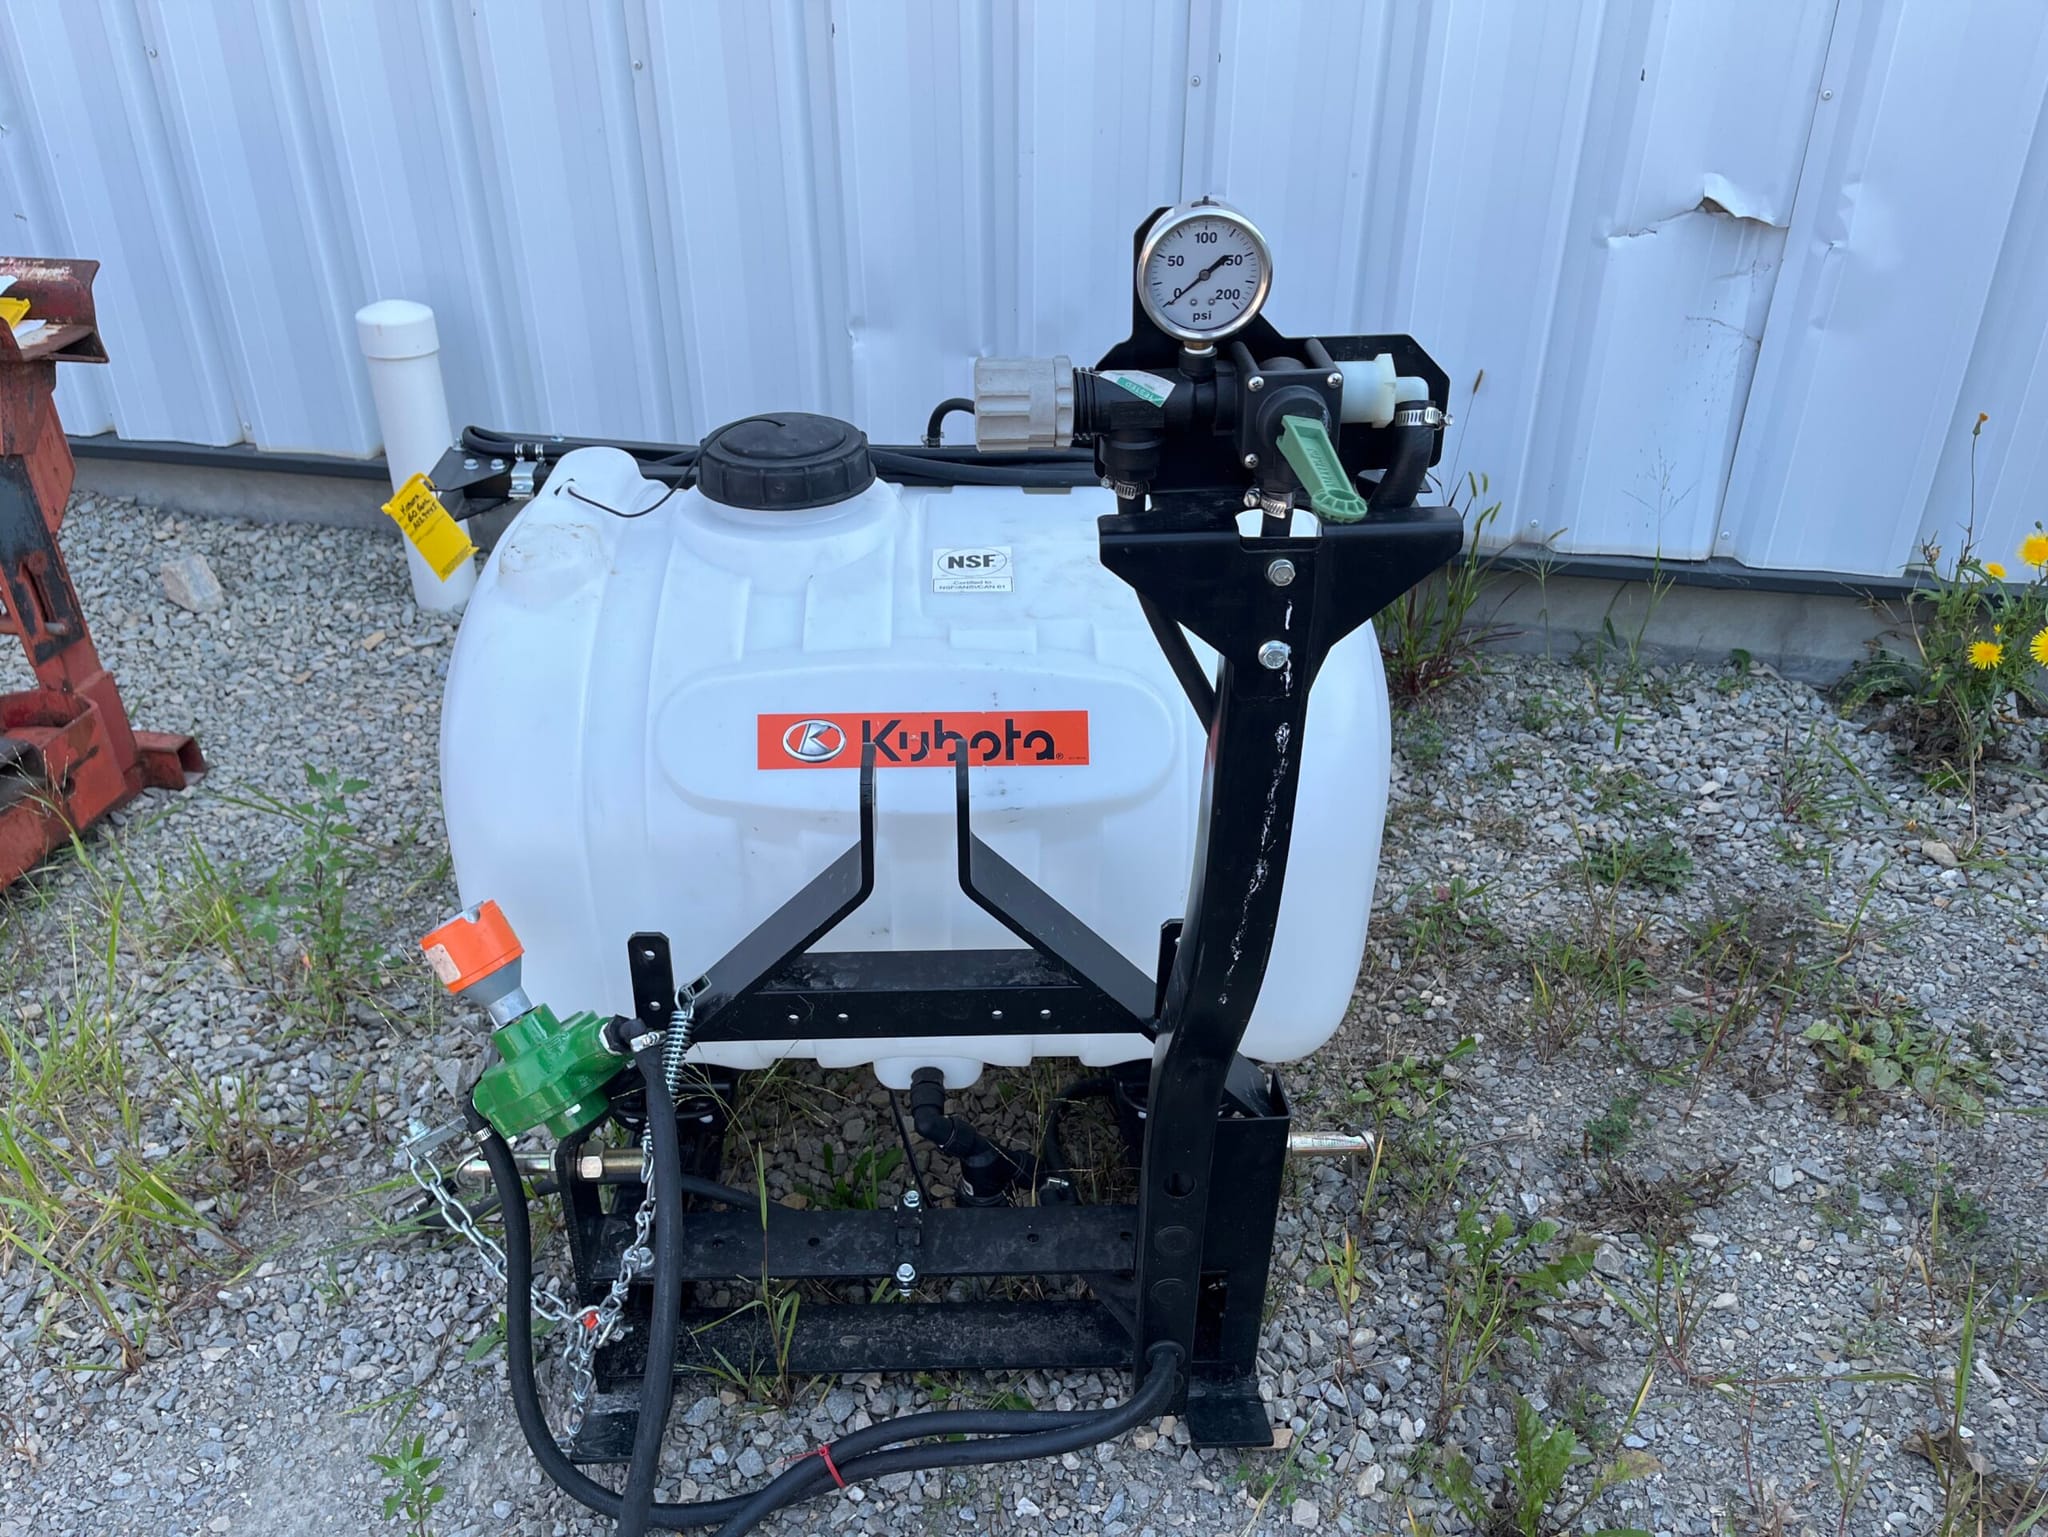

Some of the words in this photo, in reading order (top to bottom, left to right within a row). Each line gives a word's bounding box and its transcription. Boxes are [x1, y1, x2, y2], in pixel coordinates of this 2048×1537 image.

[1194, 232, 1217, 244] 100
[1167, 255, 1185, 267] 50
[1223, 254, 1243, 266] 50
[1173, 288, 1182, 299] 0
[1215, 289, 1240, 300] 200
[1192, 311, 1212, 322] psi
[947, 554, 996, 569] NSF
[861, 718, 1055, 762] Kubota
